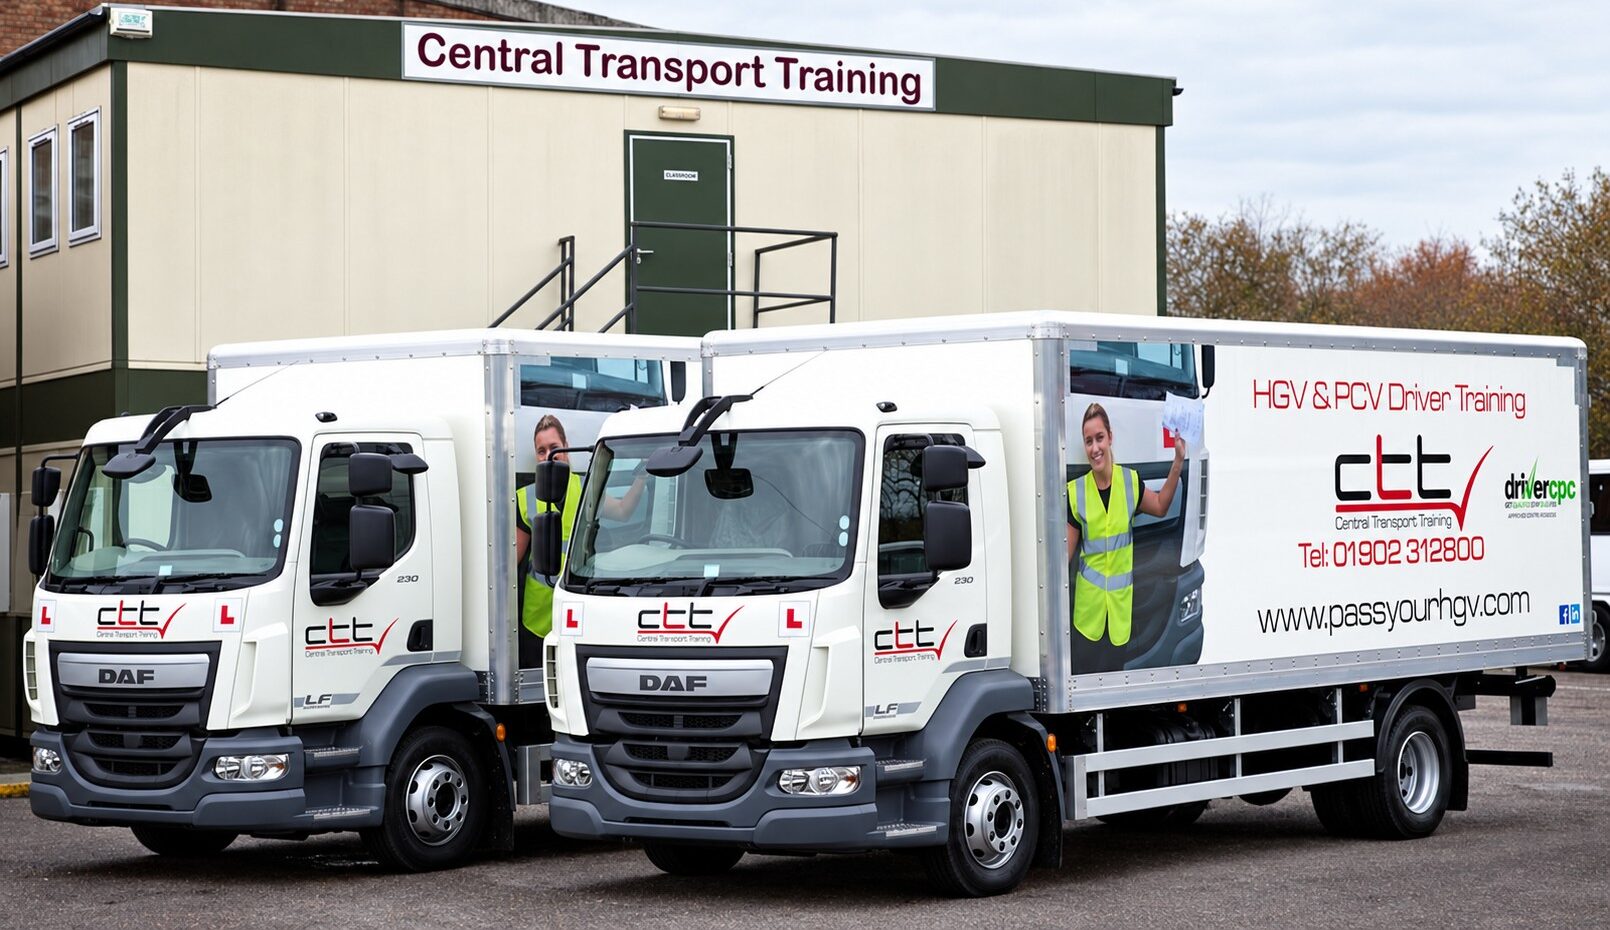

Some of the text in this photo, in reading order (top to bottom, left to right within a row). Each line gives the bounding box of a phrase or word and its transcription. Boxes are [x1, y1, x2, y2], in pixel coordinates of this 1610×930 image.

[417, 32, 921, 105] Central Transport Training
[1253, 379, 1526, 419] HGV & PCV Driver Training
[1335, 434, 1451, 501] ctt
[1505, 472, 1576, 505] drivercpc
[1335, 513, 1452, 530] Central Transport Training
[1298, 536, 1485, 568] Tel: 01902 312800
[397, 575, 419, 583] 230
[41, 606, 51, 624] L
[97, 600, 159, 625] ctt
[220, 605, 234, 624] L
[566, 609, 578, 628] L
[637, 602, 713, 629] ctt
[786, 608, 802, 628] L
[1257, 588, 1530, 635] www.passyourhgv.com
[305, 617, 373, 645] ctt
[874, 620, 935, 650] ctt
[98, 669, 154, 685] DAF
[639, 674, 707, 691] DAF
[305, 694, 332, 705] LF
[875, 703, 898, 714] LF
